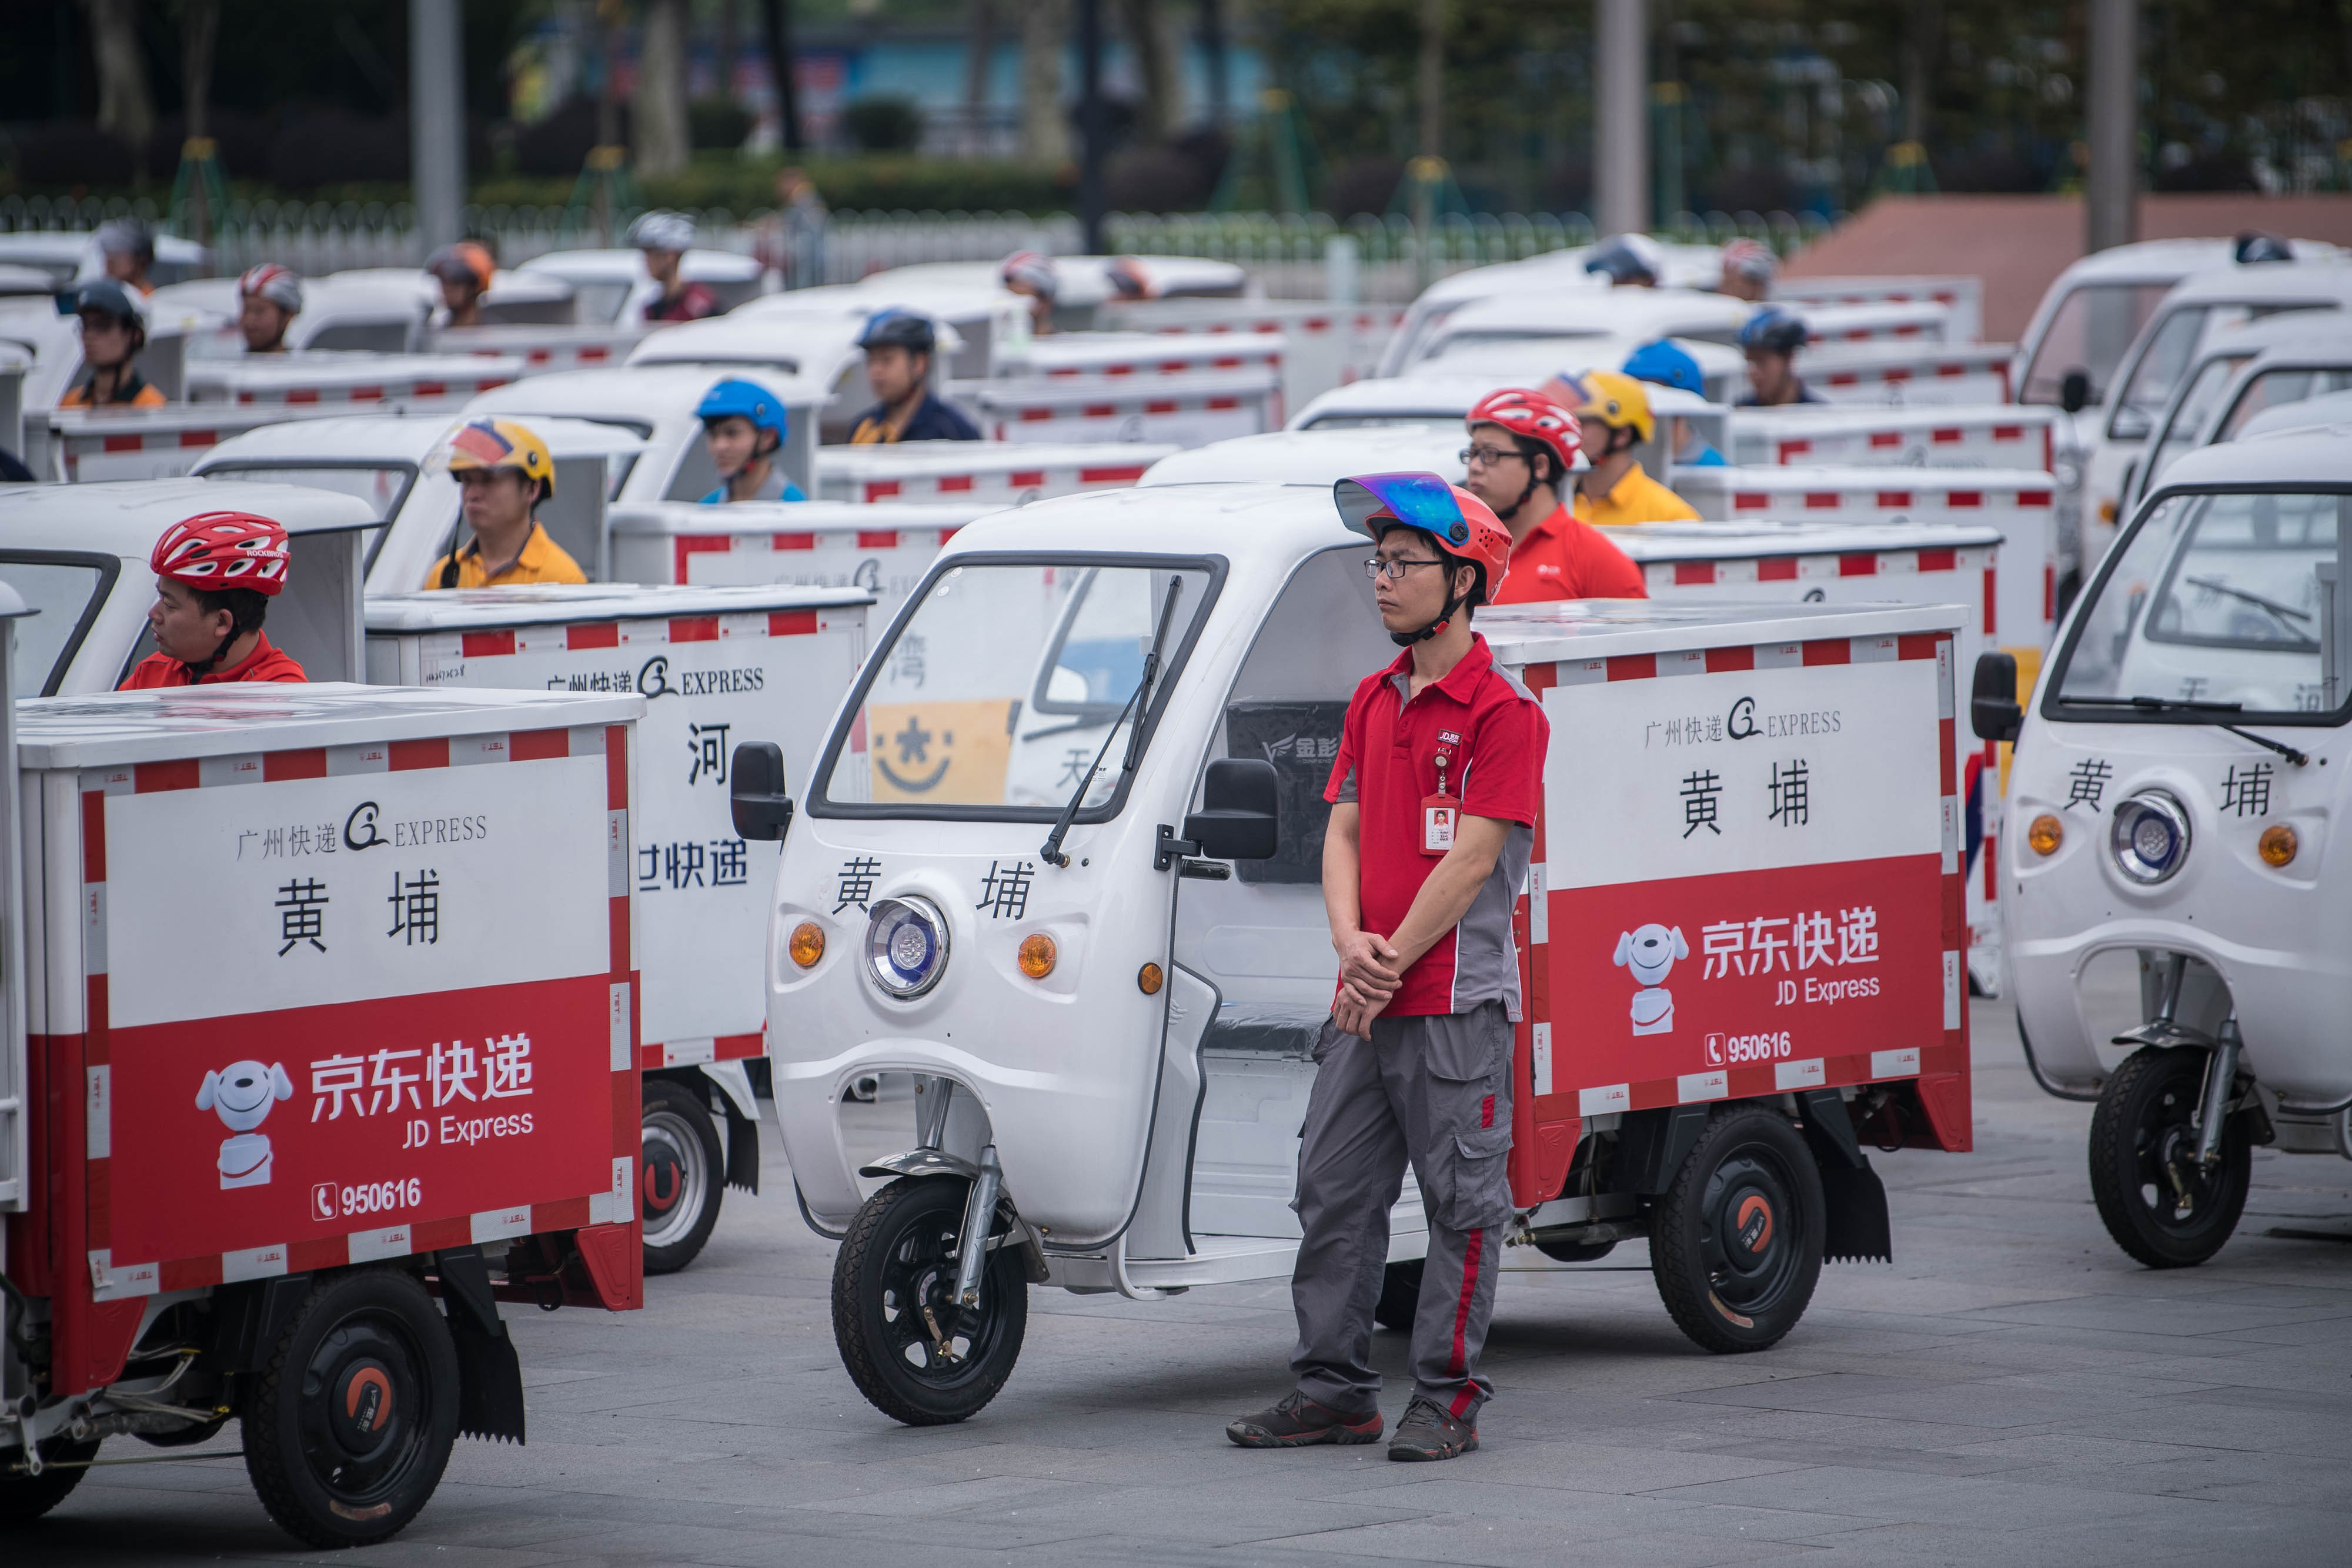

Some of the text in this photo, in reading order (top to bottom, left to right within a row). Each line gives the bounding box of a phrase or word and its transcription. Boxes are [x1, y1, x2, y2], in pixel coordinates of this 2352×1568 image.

[246, 550, 283, 558] ROCKBROS
[681, 667, 764, 696] EXPRESS
[1295, 737, 1338, 758] 金彭
[1645, 715, 1723, 749] 广州快递
[1768, 710, 1842, 738] EXPRESS
[687, 722, 731, 787] 河
[1680, 758, 1809, 839] 黄 埔
[2064, 758, 2274, 817] 黄 埔
[237, 823, 337, 861] 广州快递
[395, 815, 486, 847] EXPRESS
[831, 857, 1035, 921] 黄 埔
[275, 868, 440, 957] 黄 埔
[1702, 905, 1880, 981] 京东快递
[1775, 977, 1880, 1007] JD Express
[1728, 1031, 1792, 1064] 950616
[310, 1032, 533, 1123] 京东快递
[403, 1112, 534, 1149] JD Express
[342, 1178, 422, 1216] 950616
